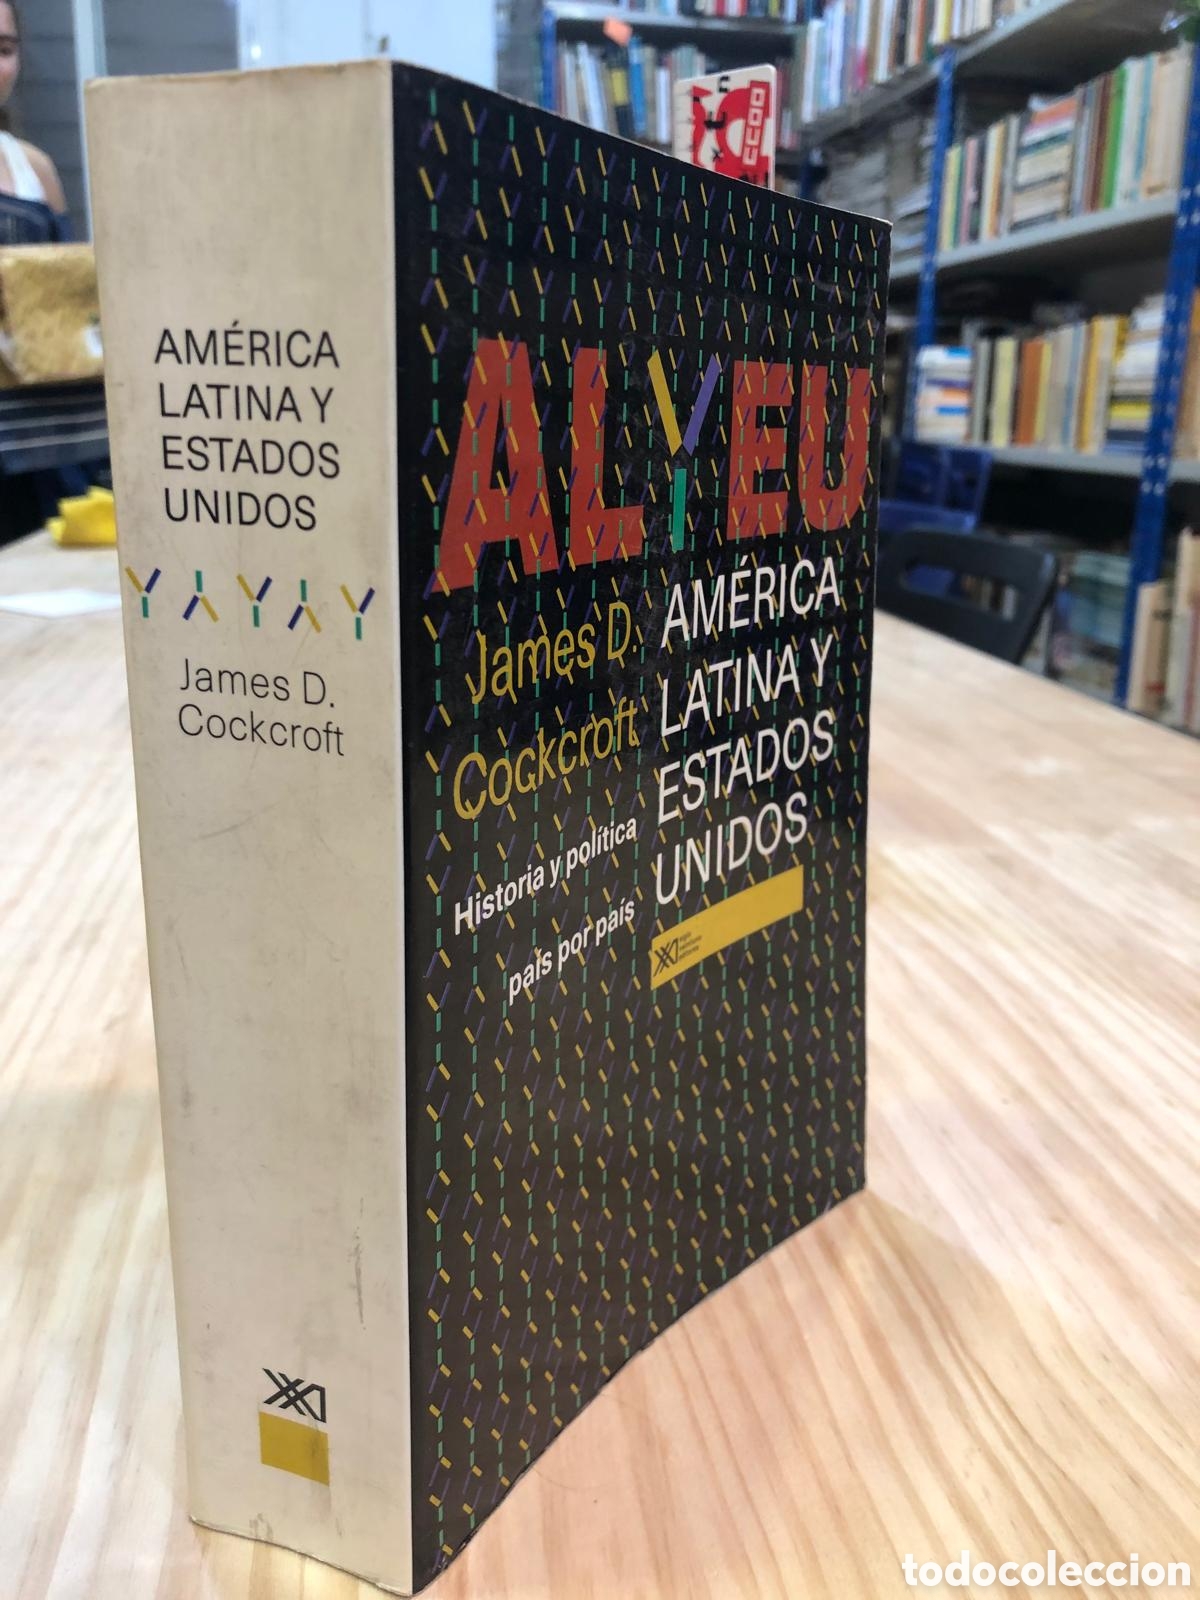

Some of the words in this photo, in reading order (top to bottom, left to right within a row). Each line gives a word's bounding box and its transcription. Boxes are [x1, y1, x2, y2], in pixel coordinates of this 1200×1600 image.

[154, 320, 340, 369] AMÉRICA
[160, 382, 302, 422] LATINA
[311, 387, 334, 423] Y
[162, 435, 340, 479] ESTADOS
[164, 487, 317, 531] UNIDOS
[660, 555, 841, 648] AMÉRICA
[180, 658, 290, 701] James
[303, 671, 335, 708] D.
[472, 624, 596, 704] James
[607, 601, 638, 661] D.
[661, 645, 800, 737] LATINA
[811, 633, 835, 687] Y
[178, 704, 344, 757] Cockcroft
[453, 699, 639, 820] Cockcroft
[658, 709, 834, 826] ESTADOS
[454, 864, 544, 935] Historia
[549, 855, 564, 888] y
[566, 815, 637, 872] política
[655, 791, 808, 905] UNIDOS
[509, 948, 553, 1006] país
[558, 930, 589, 966] por
[595, 898, 635, 944] país
